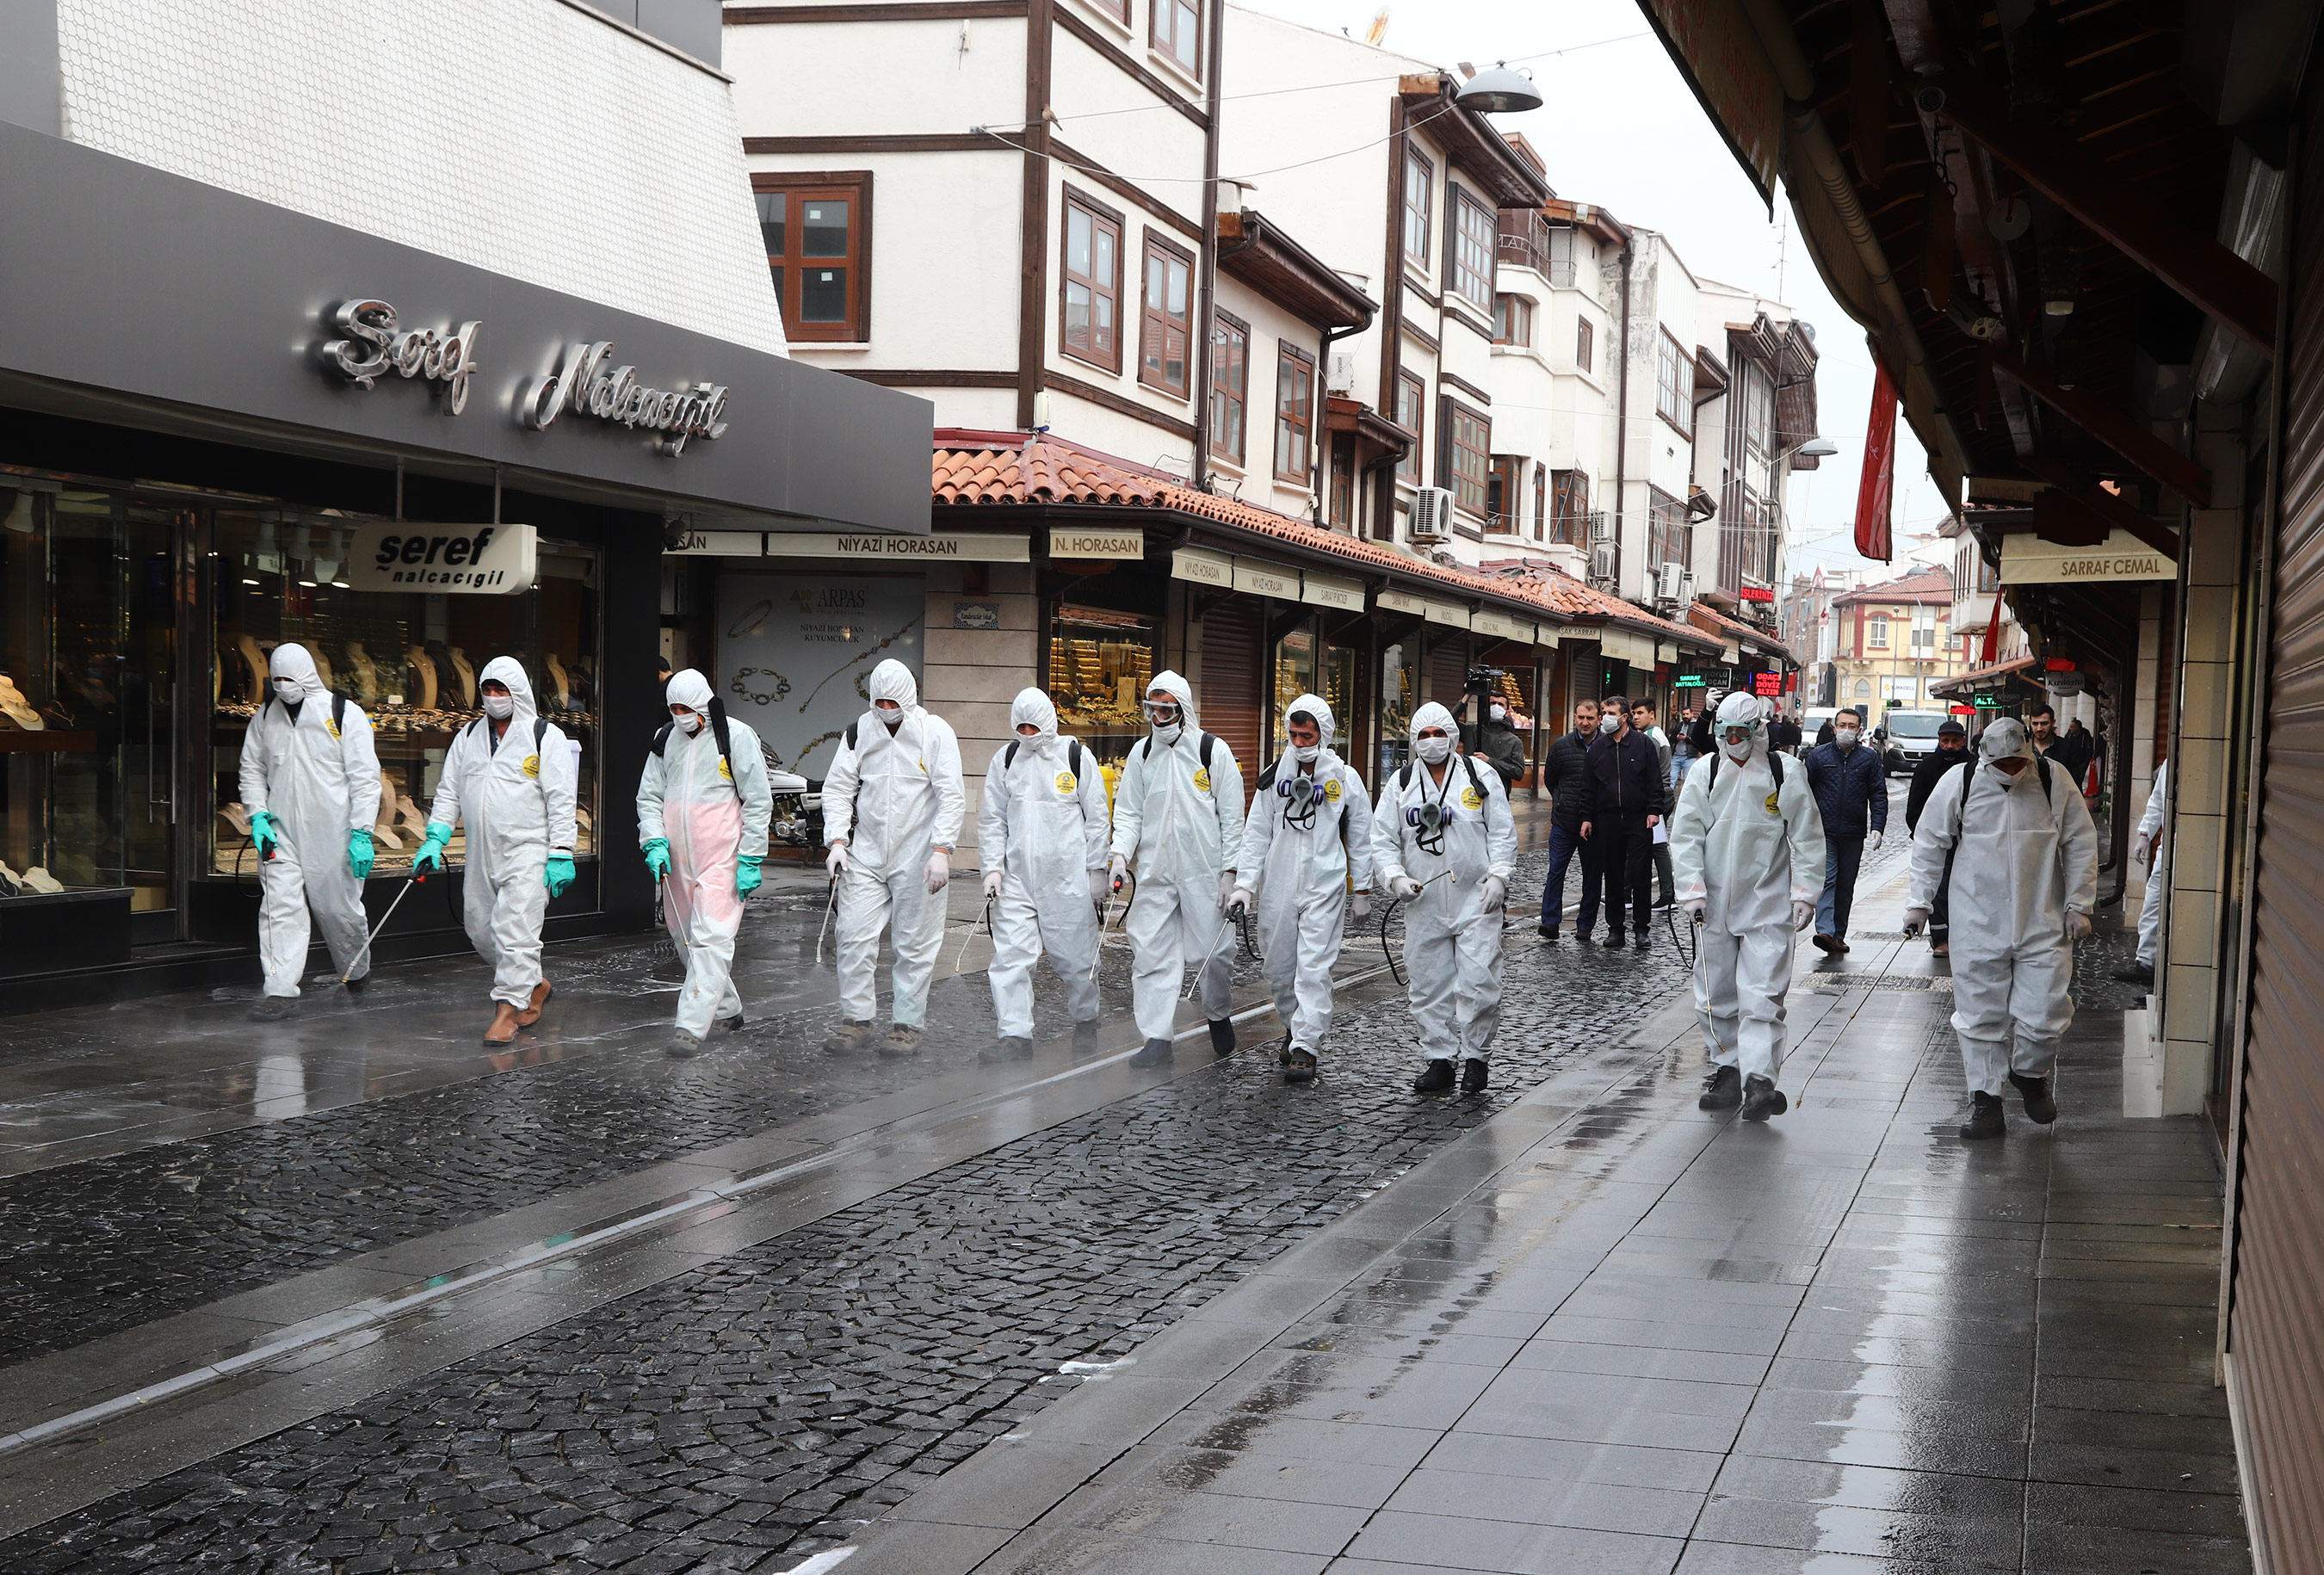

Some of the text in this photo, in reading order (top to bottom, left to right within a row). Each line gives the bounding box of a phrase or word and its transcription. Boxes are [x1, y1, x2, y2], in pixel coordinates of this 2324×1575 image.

[324, 298, 482, 417] Şeref
[375, 528, 495, 571] şeref
[838, 535, 957, 554] NİYAZİ HORASAN
[1055, 537, 1138, 553] N. HORASAN
[2061, 559, 2160, 576] SARRAF CEMAL
[817, 589, 865, 608] ARPAS
